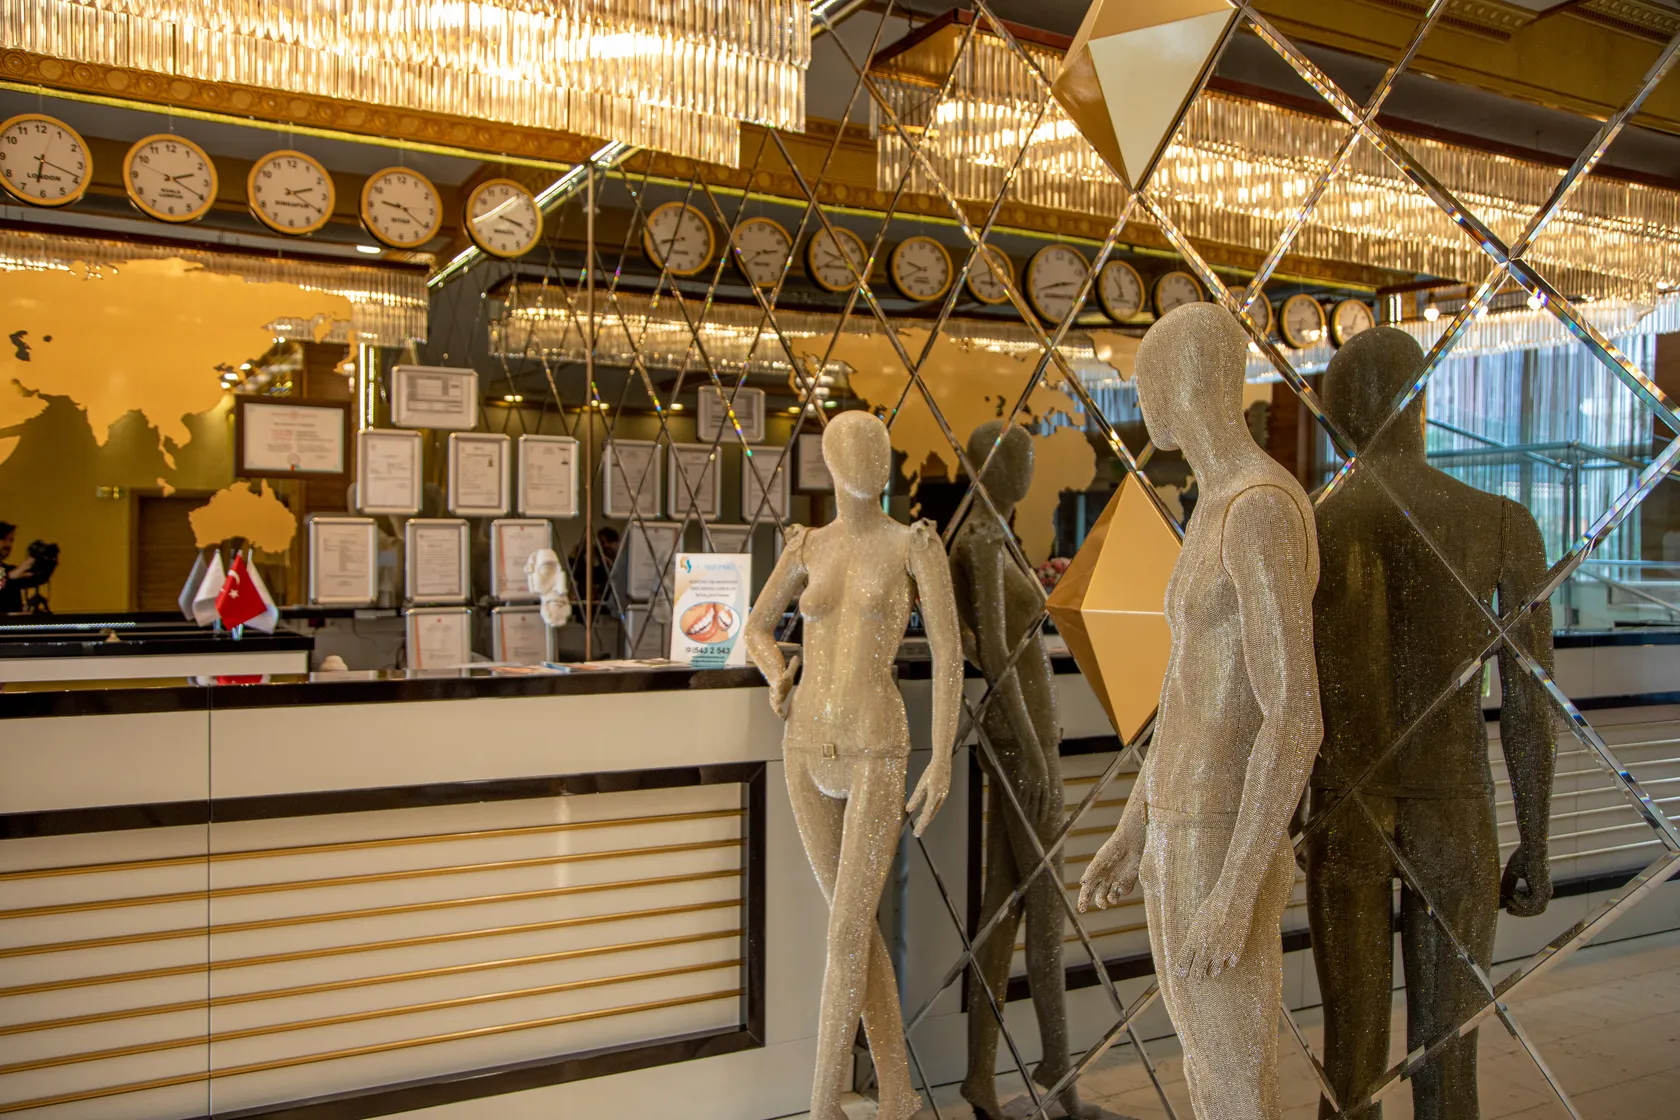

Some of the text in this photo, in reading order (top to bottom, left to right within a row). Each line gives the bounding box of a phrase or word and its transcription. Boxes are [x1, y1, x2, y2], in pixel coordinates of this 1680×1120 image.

[18, 126, 28, 135] 11
[35, 124, 47, 134] 12
[57, 131, 62, 139] 1
[6, 136, 17, 145] 10
[71, 144, 77, 153] 2
[0, 152, 6, 160] 9
[77, 161, 83, 170] 3
[6, 169, 12, 177] 8
[27, 172, 61, 181] LONDON
[20, 181, 27, 190] 7
[40, 189, 47, 198] 6
[59, 187, 66, 196] 5
